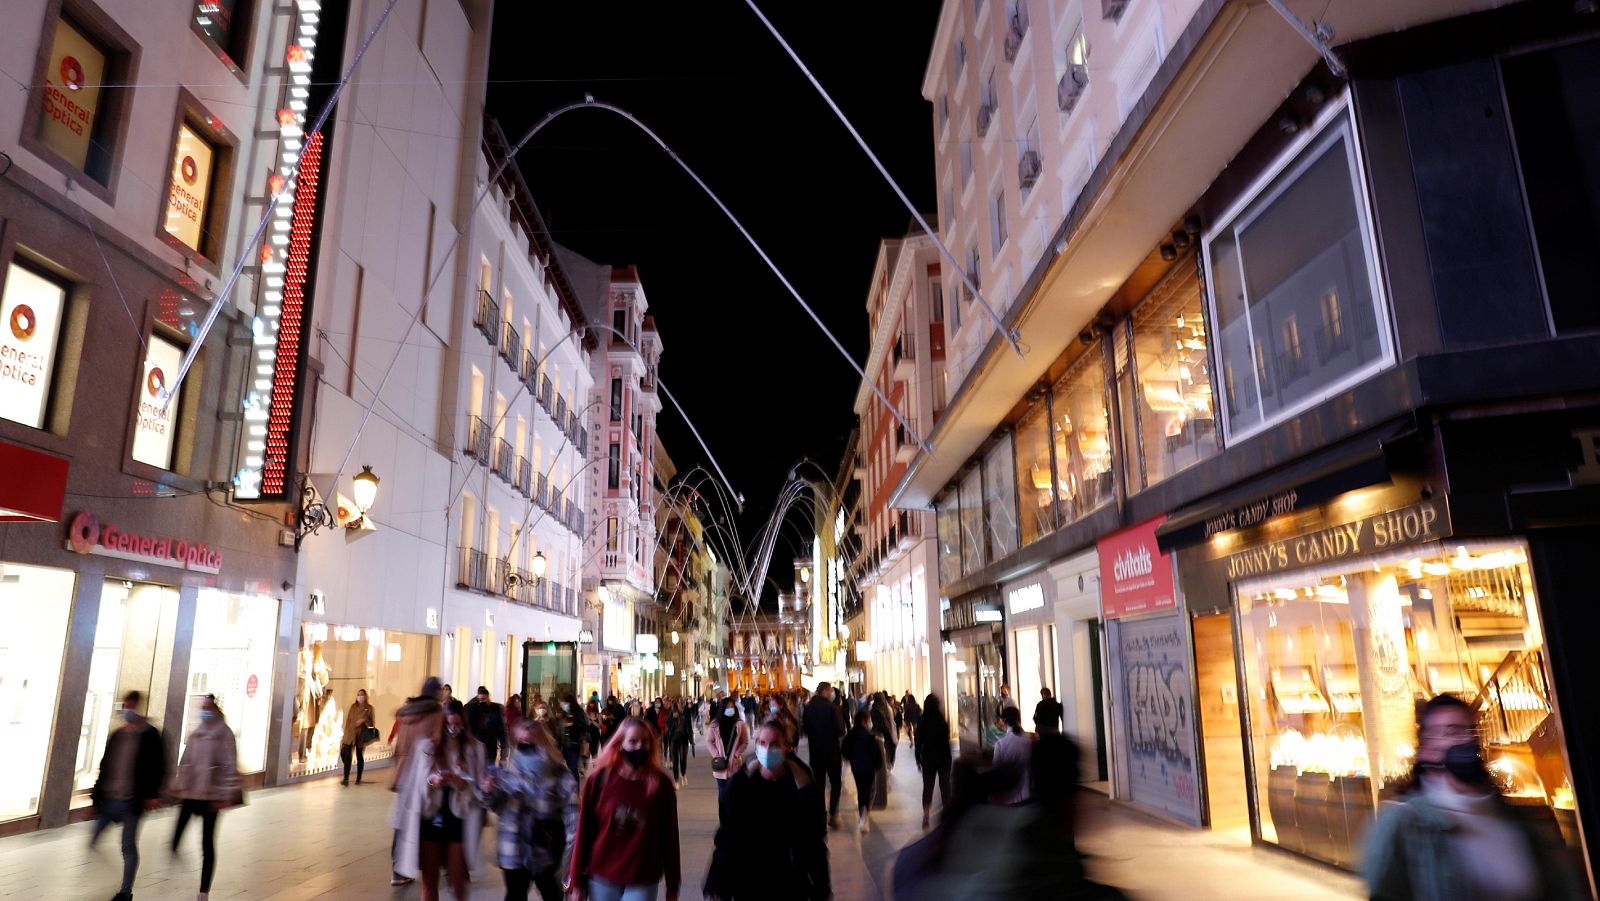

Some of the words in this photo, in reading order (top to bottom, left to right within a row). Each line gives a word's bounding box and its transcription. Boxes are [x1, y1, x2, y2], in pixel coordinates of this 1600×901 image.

[43, 98, 82, 136] Optica
[45, 80, 90, 124] General
[169, 193, 197, 222] Optica
[0, 345, 43, 371] eneral
[136, 411, 165, 434] Optica
[1204, 512, 1236, 538] JONNY'S
[1239, 499, 1269, 528] CANDY
[1272, 490, 1297, 517] SHOP
[102, 523, 172, 560] General
[174, 538, 223, 570] Optica
[1228, 544, 1288, 578] JONNY'S
[1295, 520, 1363, 563] CANDY
[1372, 503, 1437, 547] SHOP
[1113, 546, 1152, 582] civitatis
